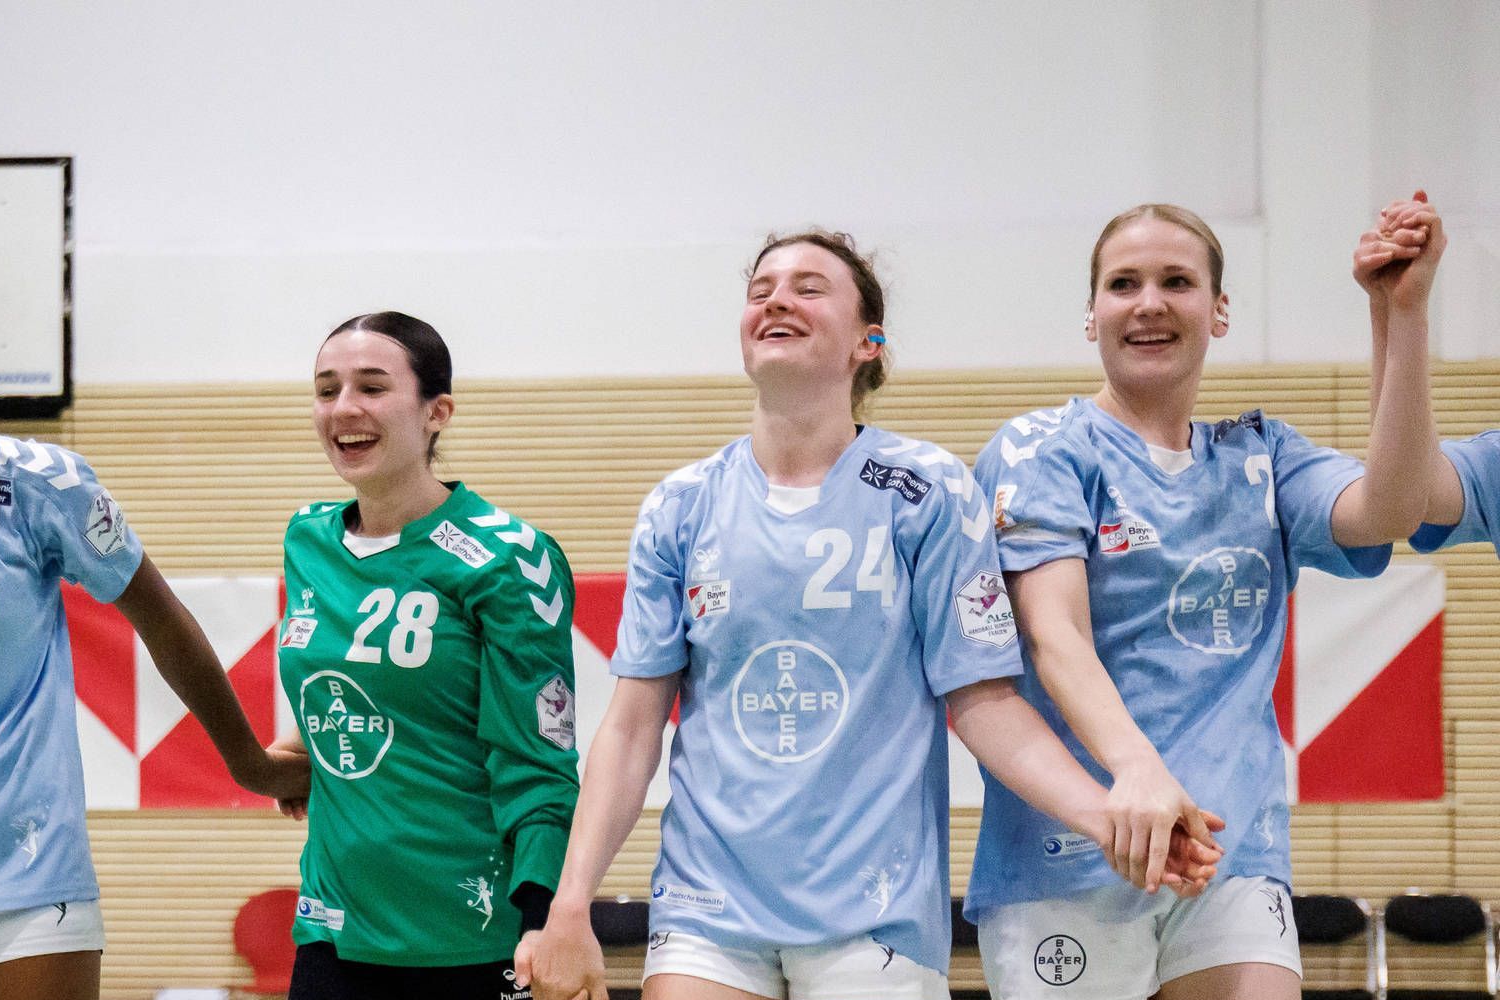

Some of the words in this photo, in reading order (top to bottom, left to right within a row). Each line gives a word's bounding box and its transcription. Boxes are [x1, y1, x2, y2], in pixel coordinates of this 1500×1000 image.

[802, 525, 897, 610] 24
[707, 591, 727, 600] Bayer
[344, 587, 440, 669] 28
[742, 691, 839, 712] BAYER
[776, 651, 798, 753] BAYER
[306, 715, 385, 734] BAYER
[328, 680, 357, 771] BAYER
[1038, 956, 1082, 965] BAYER
[1054, 939, 1064, 982] BAYER
[500, 990, 533, 1000] humm
